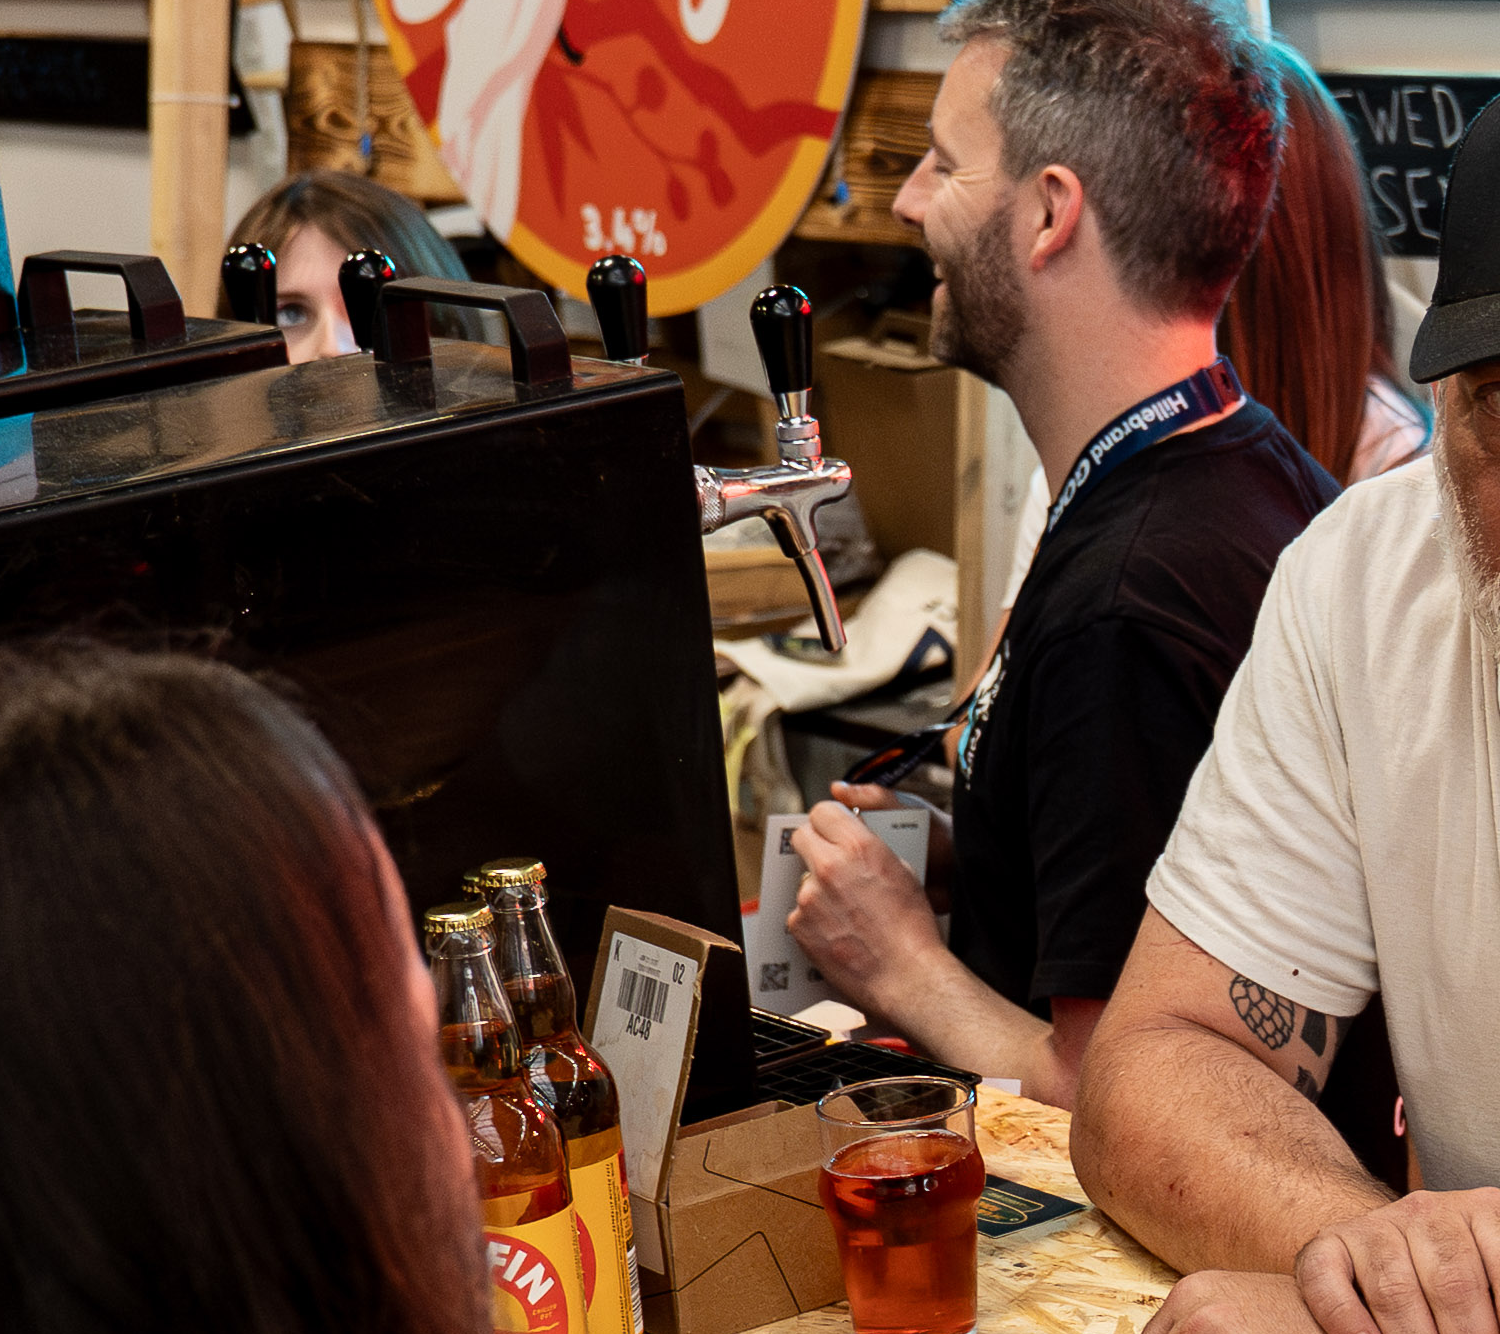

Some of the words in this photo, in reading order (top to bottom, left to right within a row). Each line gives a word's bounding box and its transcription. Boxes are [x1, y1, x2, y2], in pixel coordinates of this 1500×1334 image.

[1331, 84, 1465, 150] WED
[578, 202, 668, 257] 3.4%
[1087, 389, 1191, 467] Hillebrand
[613, 939, 624, 962] K
[672, 961, 687, 986] 02
[625, 1013, 653, 1042] AC48
